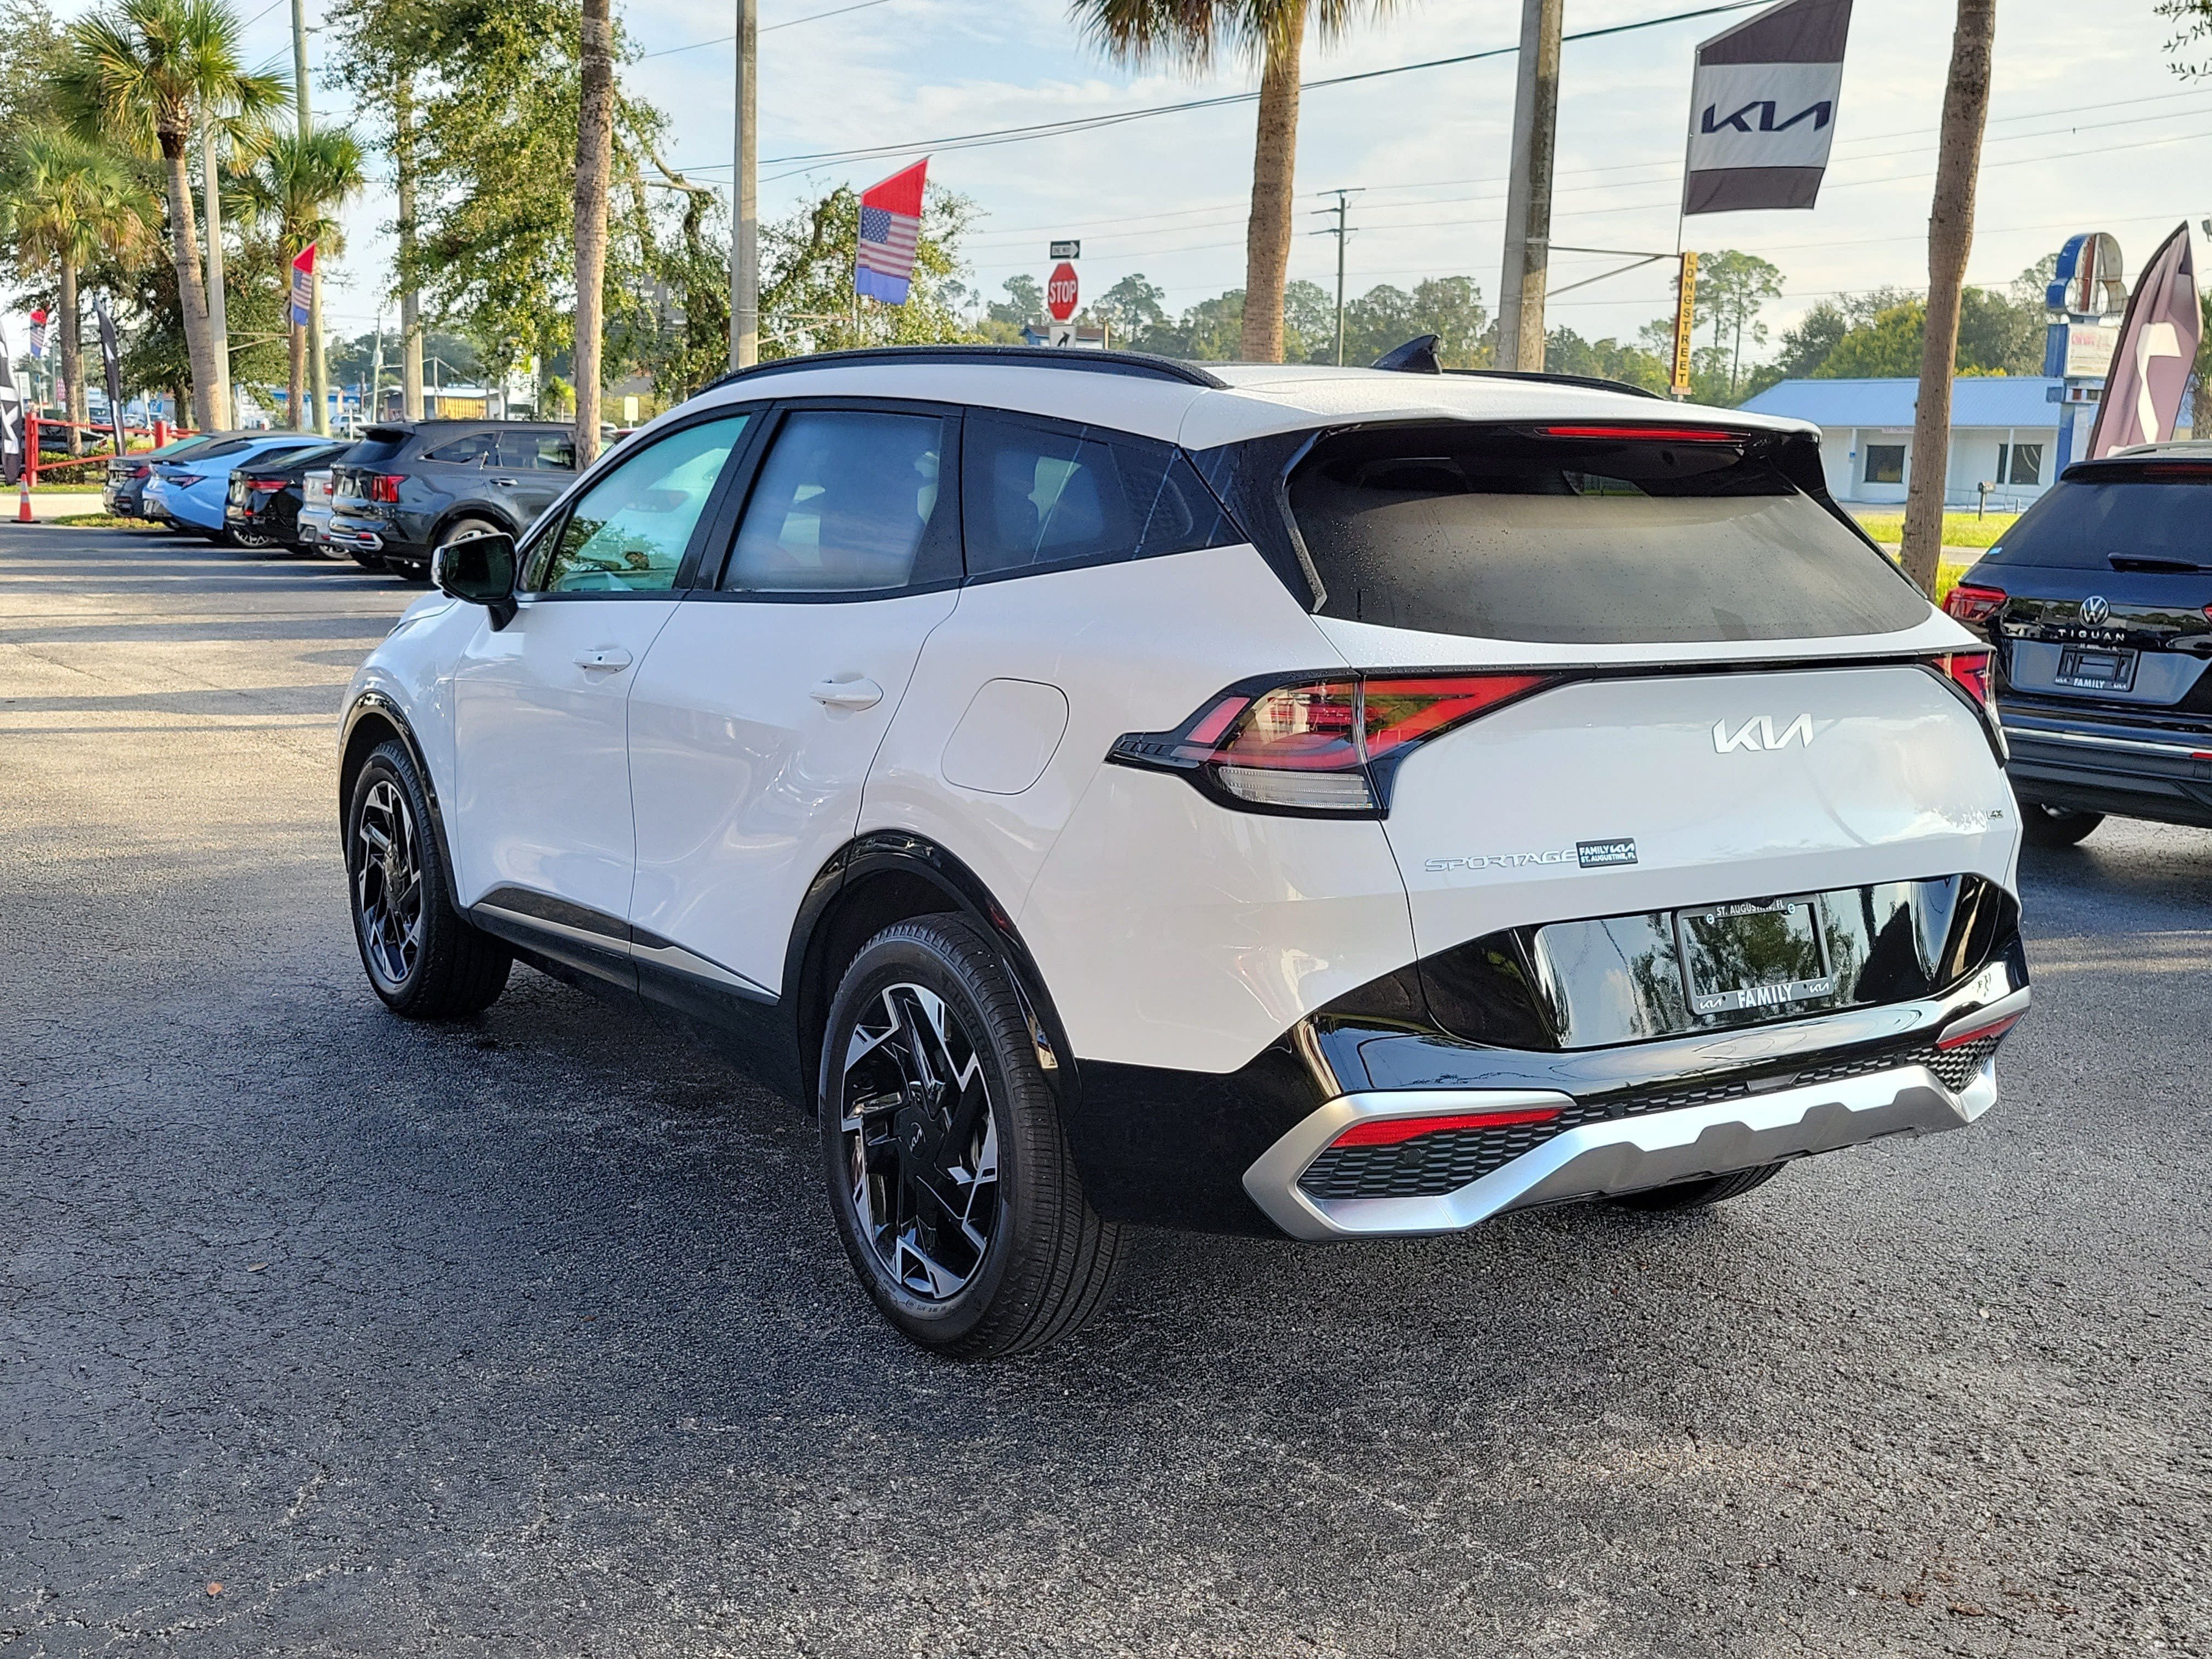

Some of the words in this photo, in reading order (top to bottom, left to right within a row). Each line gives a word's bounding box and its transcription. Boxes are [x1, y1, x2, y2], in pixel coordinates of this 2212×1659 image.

[1701, 100, 1831, 133] KIA
[1049, 280, 1076, 303] STOP
[1678, 253, 1695, 383] LONGSTREET
[2057, 628, 2125, 641] TIGUAN
[2074, 678, 2105, 689] FAMILY
[1712, 713, 1814, 754] KIA
[1425, 848, 1578, 872] SPORTAGE
[1579, 845, 1609, 856] FAMILY
[1610, 843, 1635, 853] KIA
[1591, 853, 1628, 862] AUGUSTINE,
[1716, 906, 1728, 916] ST.
[1775, 899, 1785, 909] FL
[1700, 998, 1722, 1009] KIA
[1737, 984, 1792, 1008] FAMILY
[1809, 982, 1830, 993] KIA
